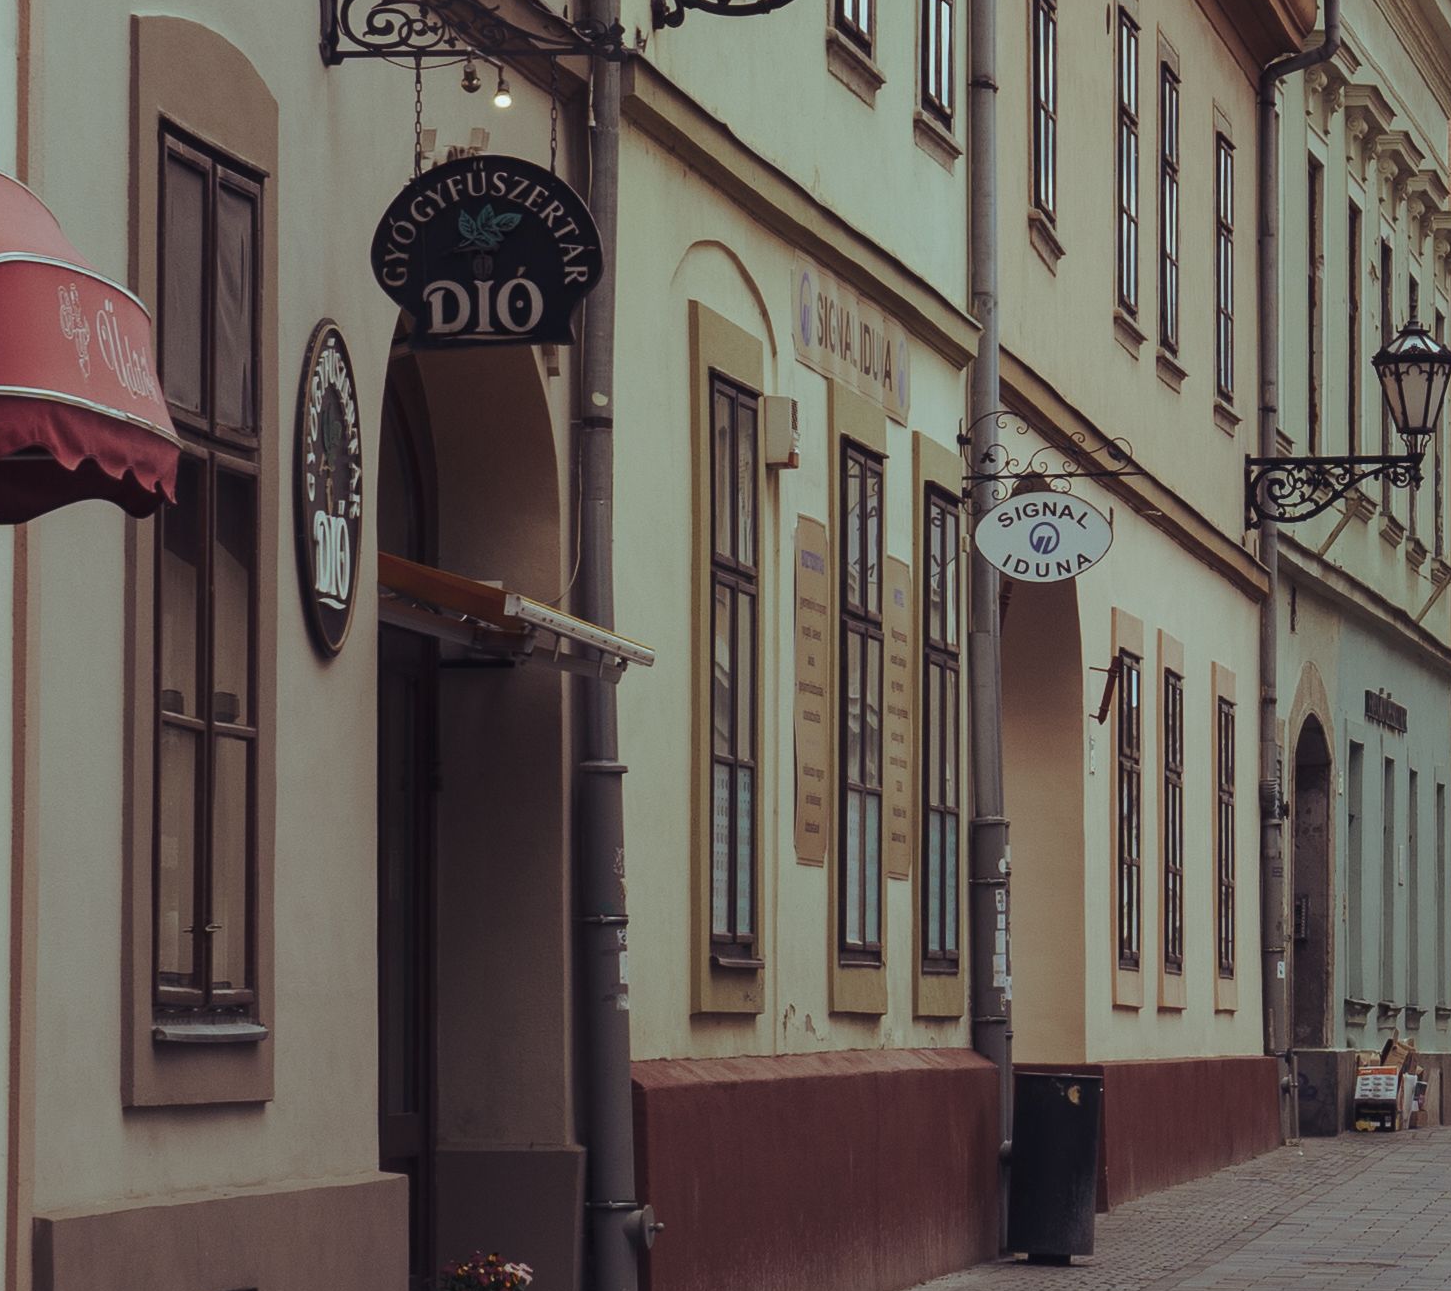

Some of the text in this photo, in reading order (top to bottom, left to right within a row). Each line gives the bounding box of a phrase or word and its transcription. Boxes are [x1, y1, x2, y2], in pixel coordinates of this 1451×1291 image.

[423, 266, 544, 334] DIÓ
[816, 291, 857, 369] SIGNAL
[312, 499, 350, 600] DIÓ
[997, 501, 1088, 530] SIGNAL
[1002, 553, 1093, 578] IDUNA
